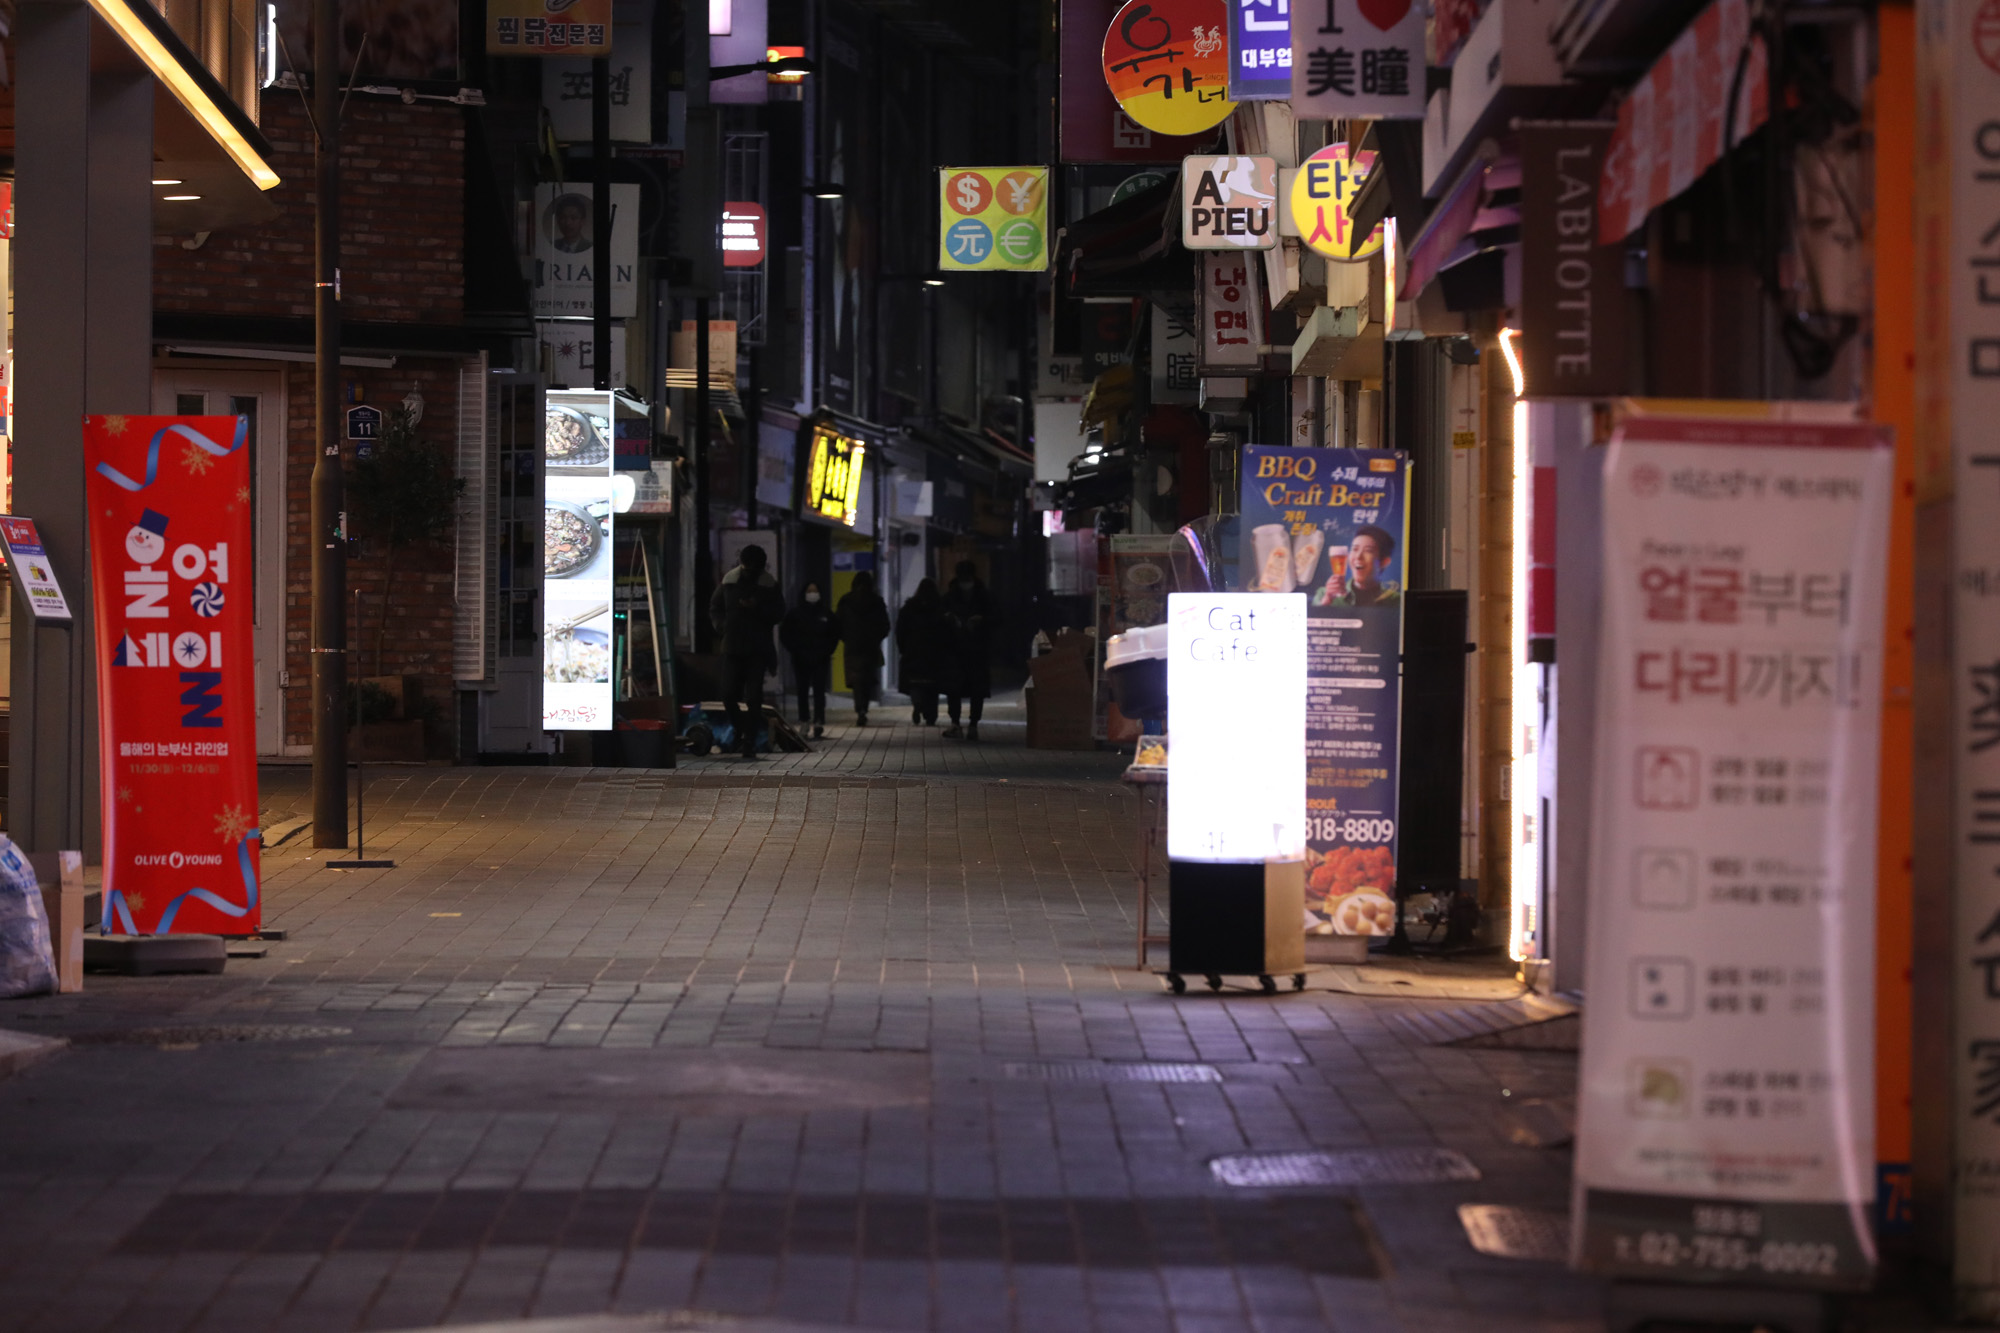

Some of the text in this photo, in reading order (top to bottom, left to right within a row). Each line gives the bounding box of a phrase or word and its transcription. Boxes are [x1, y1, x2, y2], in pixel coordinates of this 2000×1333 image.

[1306, 47, 1410, 97] 美瞳
[1192, 208, 1269, 236] PIEU
[953, 225, 986, 256] 元
[549, 263, 632, 283] RIAN
[1556, 146, 1592, 377] LABIOTTE
[1214, 266, 1249, 346] 냉면
[358, 422, 371, 436] 11
[1256, 455, 1318, 481] BBQ
[1264, 482, 1386, 507] Craft Beer
[1639, 566, 1851, 628] 얼굴부터
[1208, 606, 1256, 631] Cat
[1190, 638, 1258, 661] Cafe
[1634, 648, 1862, 708] 다리까지!
[120, 742, 229, 756] 올해의 눈부신 라인업
[135, 855, 222, 865] OLIVE YOUNG
